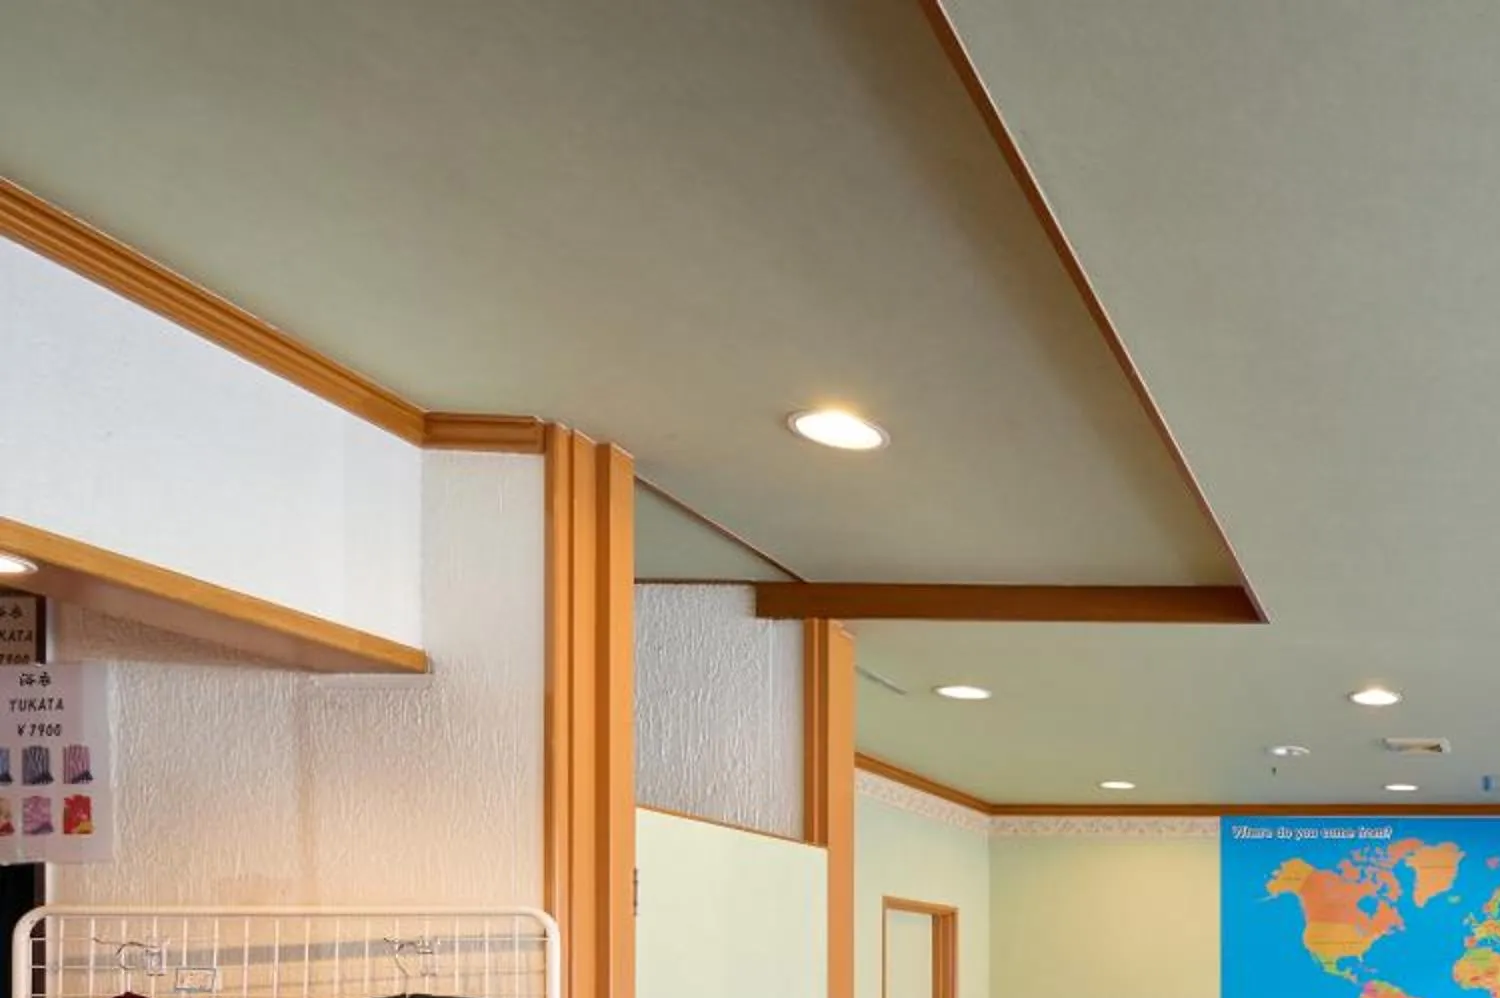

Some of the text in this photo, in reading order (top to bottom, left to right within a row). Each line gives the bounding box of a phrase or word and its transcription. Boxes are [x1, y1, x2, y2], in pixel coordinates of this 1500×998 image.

[1232, 825, 1273, 839] Where
[1277, 826, 1293, 839] do
[1295, 828, 1318, 841] you
